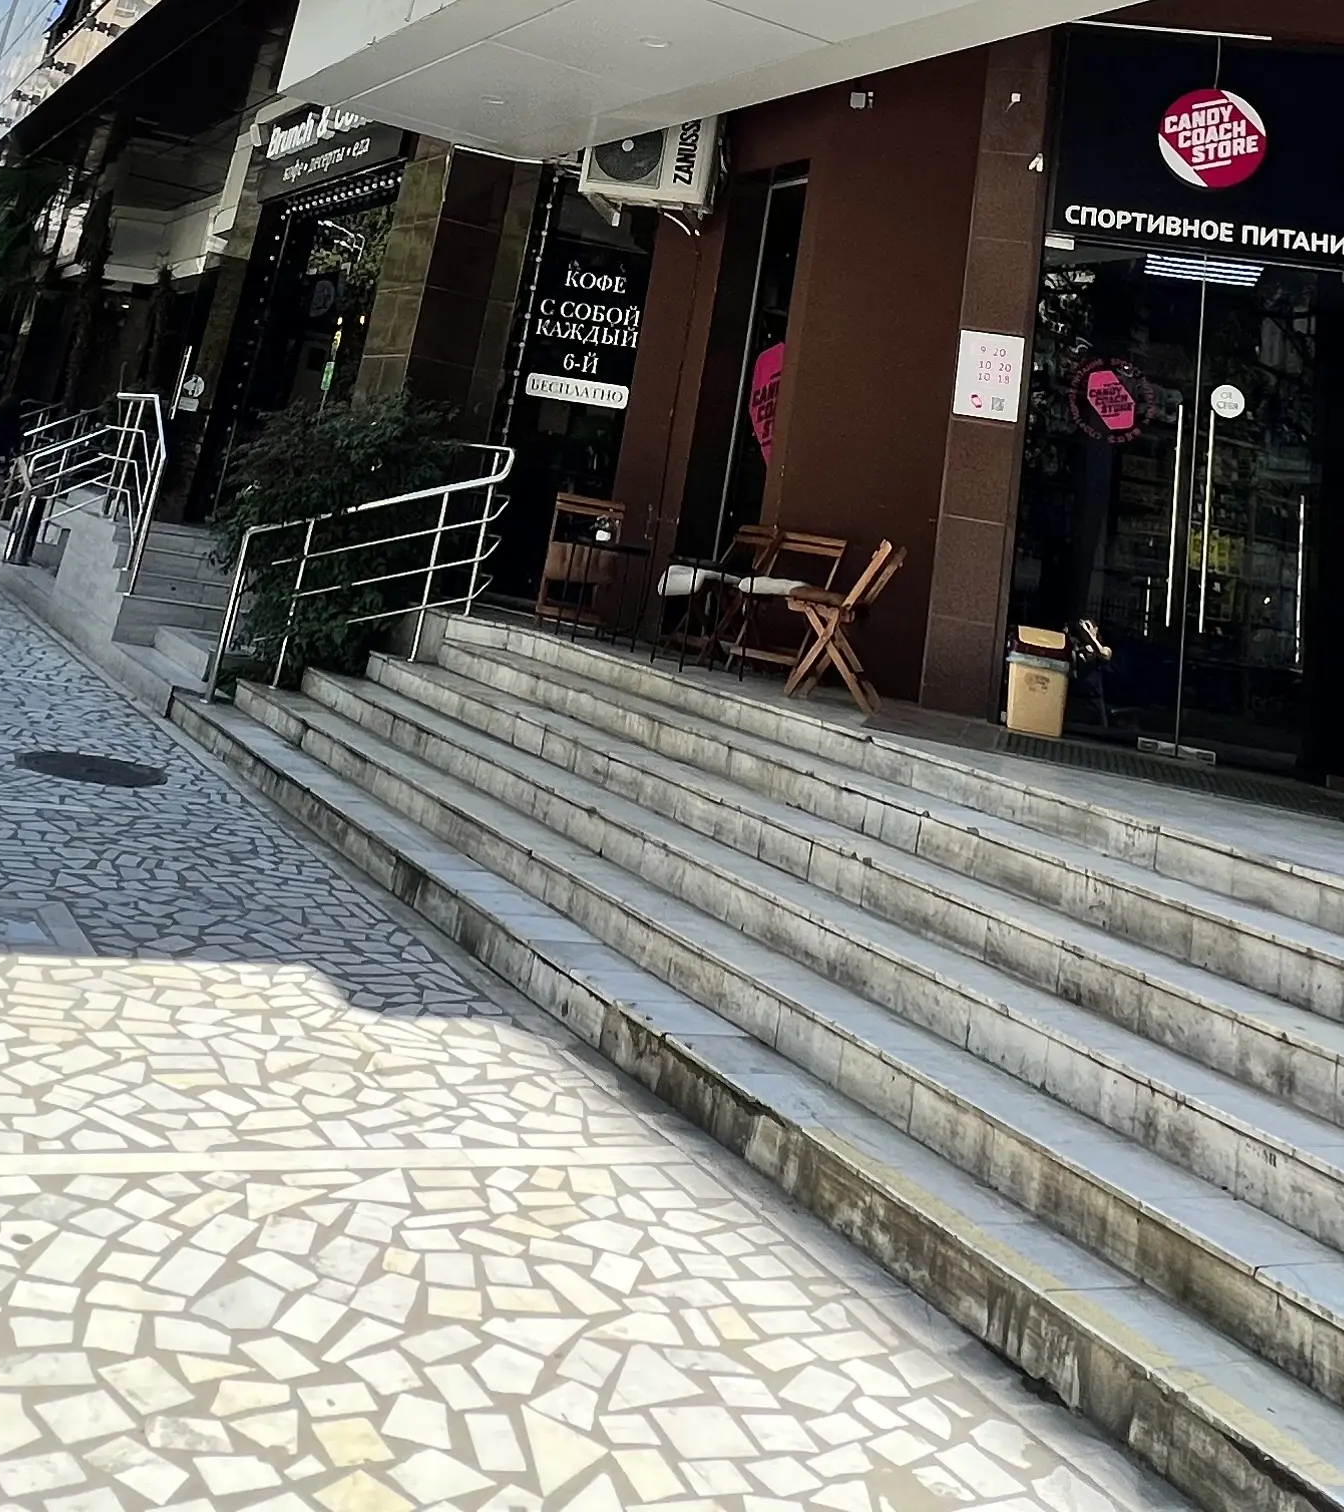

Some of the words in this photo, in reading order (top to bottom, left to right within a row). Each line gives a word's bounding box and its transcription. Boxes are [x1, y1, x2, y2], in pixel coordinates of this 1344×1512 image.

[1164, 104, 1233, 133] CANDY
[1178, 119, 1246, 148] COACH
[1191, 135, 1258, 163] STORE
[1065, 204, 1234, 243] СПОРТИВНОЕ
[564, 270, 627, 294] КОФЕ
[540, 298, 556, 316] С
[560, 301, 640, 327] СОБОЙ
[535, 318, 639, 348] КАЖДЫЙ
[563, 351, 599, 374] 6-Й
[531, 378, 624, 404] БЕСПЛАТНО
